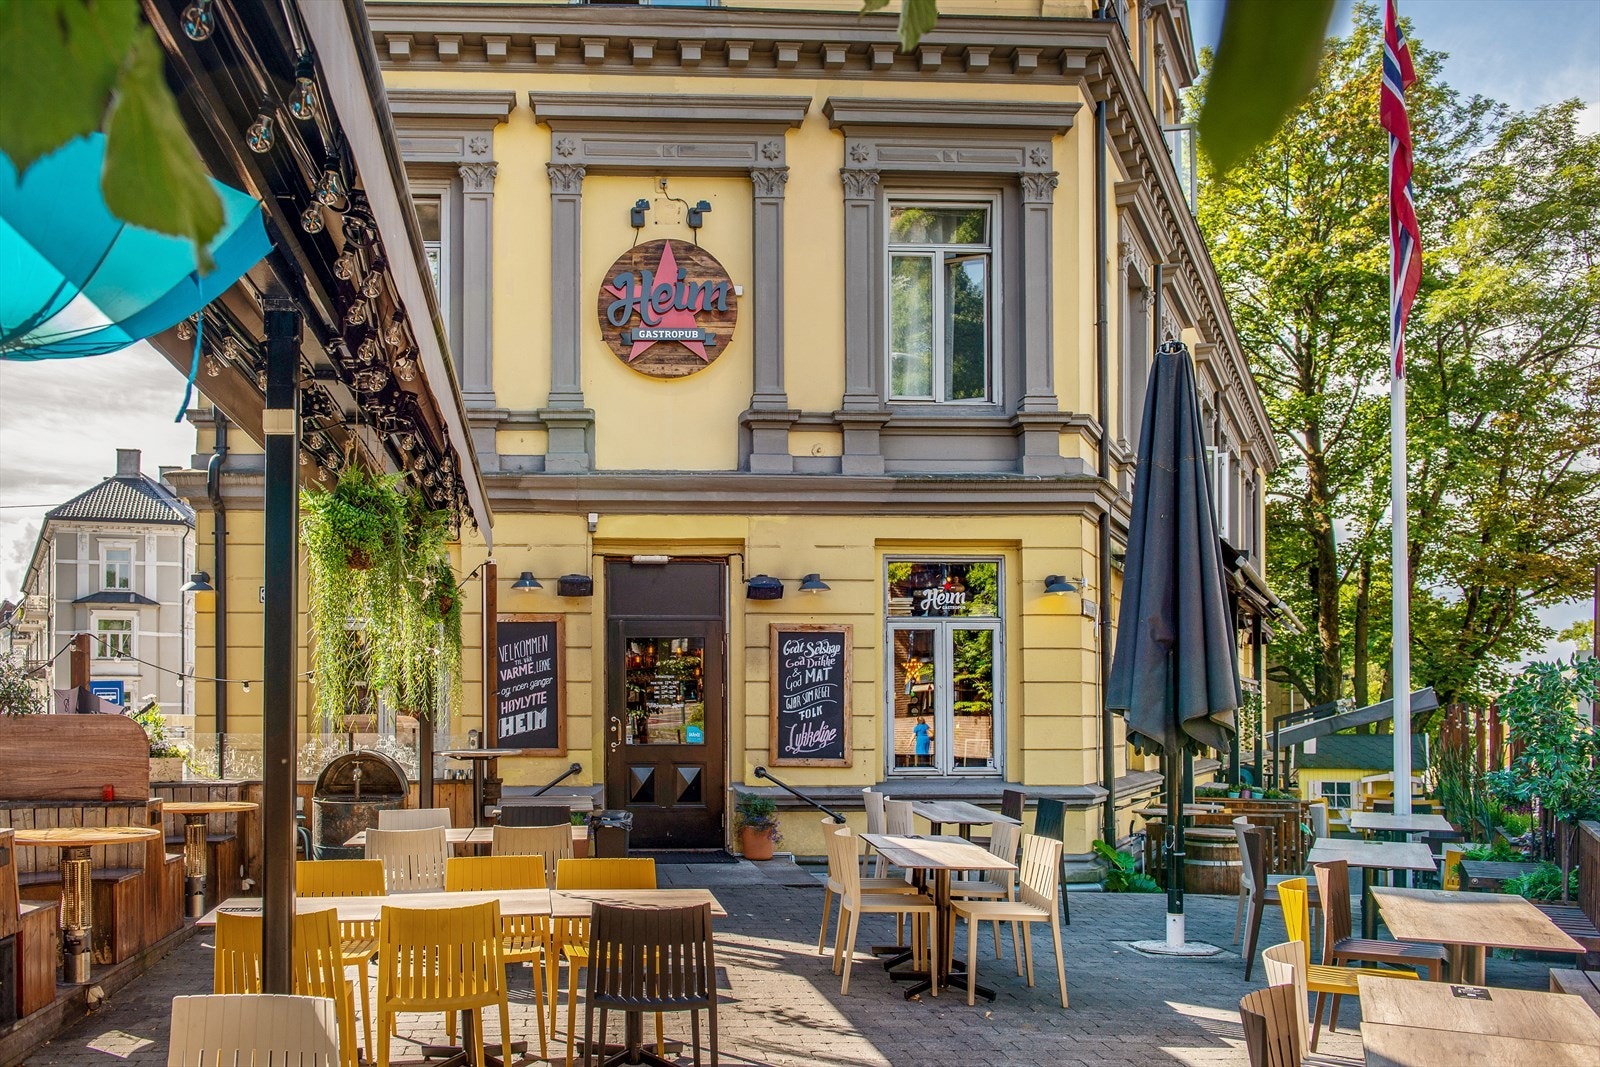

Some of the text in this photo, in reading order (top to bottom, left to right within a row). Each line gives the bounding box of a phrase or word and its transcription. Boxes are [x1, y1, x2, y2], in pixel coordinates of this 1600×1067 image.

[607, 268, 729, 327] Heim
[638, 330, 699, 339] GASTROPUB
[920, 588, 966, 611] Heim
[499, 634, 548, 663] VELKOMMEN
[783, 638, 805, 656] Godt
[523, 656, 533, 664] VÅR
[785, 655, 836, 669] God Drikke
[785, 667, 833, 692] God MAT
[792, 667, 801, 678] &
[512, 682, 529, 692] noen
[529, 677, 553, 691] ganger
[500, 691, 547, 715] HØYLYTTE
[802, 690, 814, 705] SOM
[814, 685, 830, 701] REGEL
[498, 707, 547, 739] HEIM
[798, 705, 823, 721] FOLK
[785, 720, 837, 754] Lykkelige
